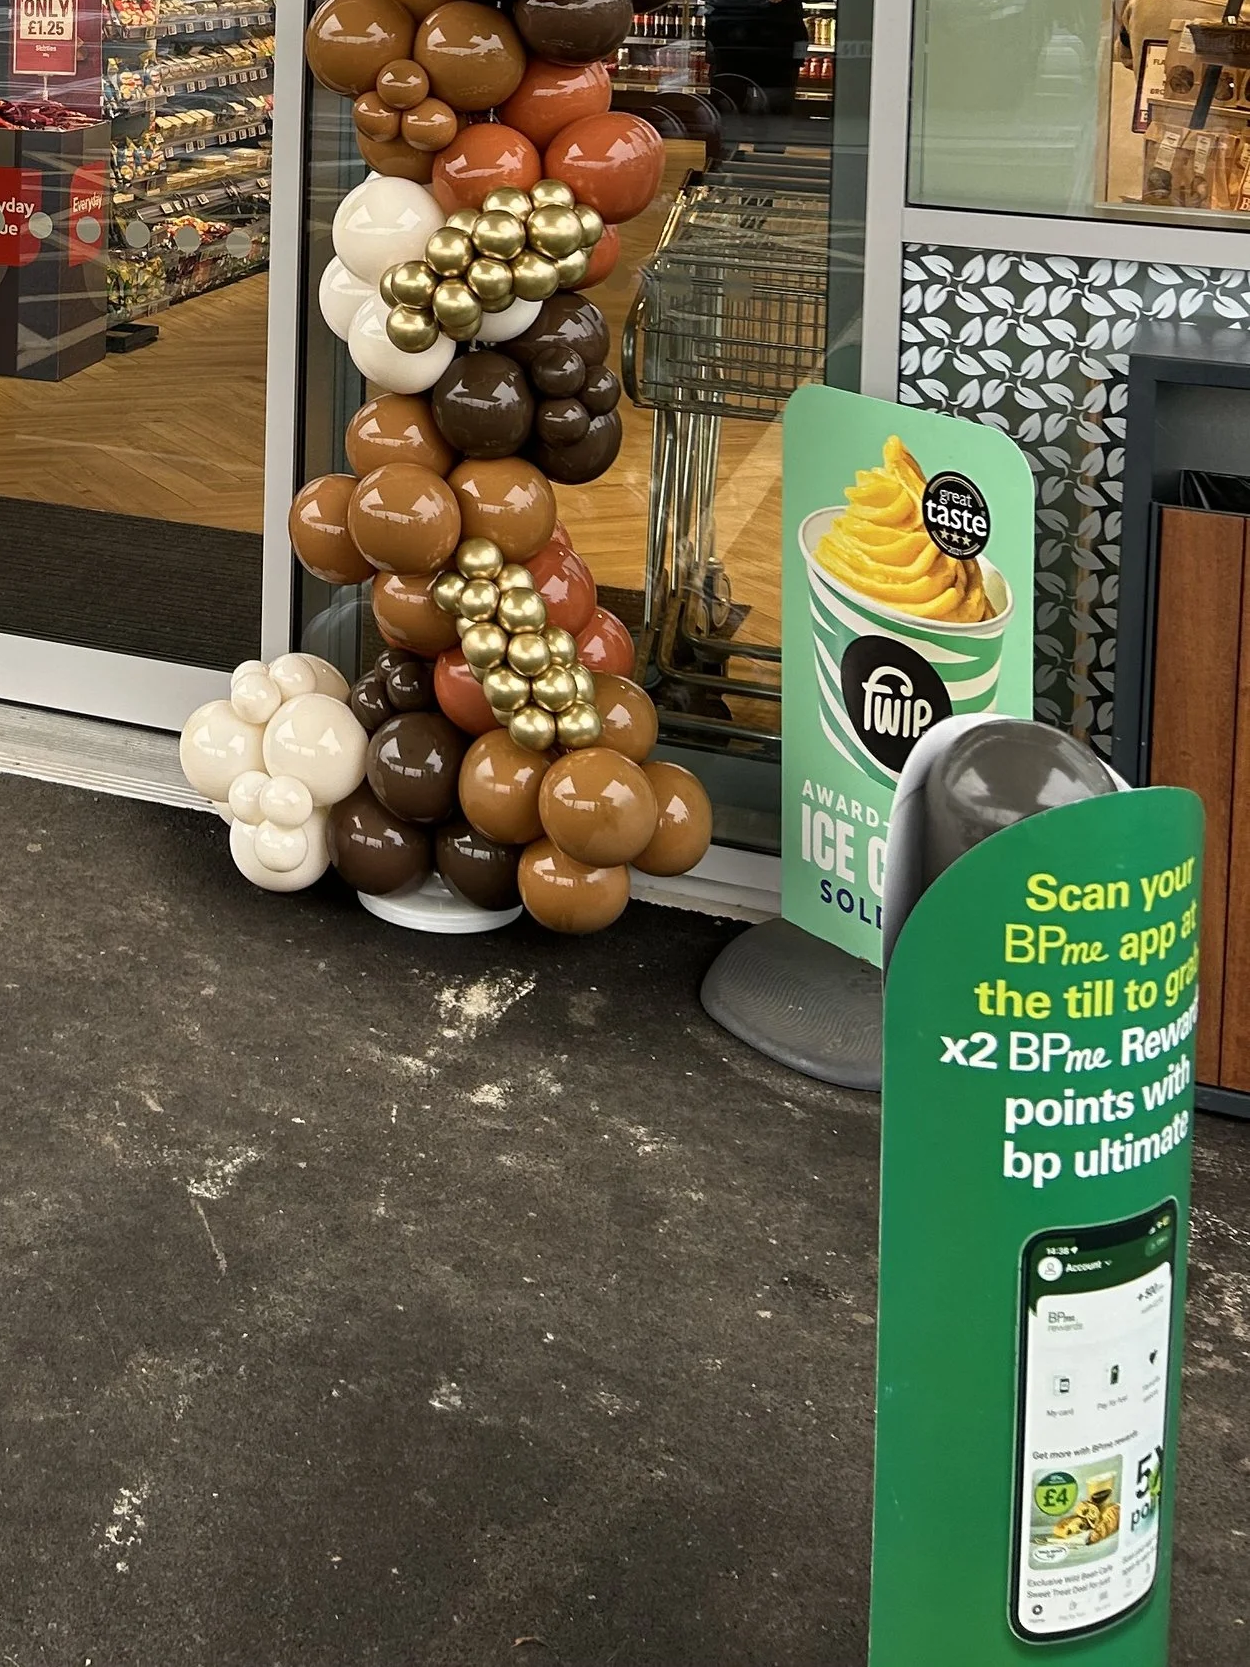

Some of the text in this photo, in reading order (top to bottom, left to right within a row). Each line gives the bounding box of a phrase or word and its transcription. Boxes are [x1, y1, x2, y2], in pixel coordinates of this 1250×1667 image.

[27, 20, 65, 36] £1.25
[72, 192, 103, 213] Everyday
[925, 499, 987, 537] taste
[939, 489, 973, 508] great
[801, 802, 855, 884] ICE
[1025, 856, 1195, 912] Scan your
[1004, 898, 1198, 966] BPme app at
[974, 979, 1052, 1020] the
[1063, 979, 1114, 1019] till
[1123, 978, 1158, 1012] to
[939, 1031, 998, 1070] x2
[1009, 1030, 1113, 1073] BPme
[1005, 1054, 1191, 1134] points with
[1003, 1110, 1190, 1189] bp ultimate
[1065, 1260, 1102, 1273] Account
[1032, 1450, 1049, 1460] Get
[1049, 1450, 1072, 1459] more
[1073, 1446, 1091, 1456] with
[1042, 1489, 1069, 1507] £4
